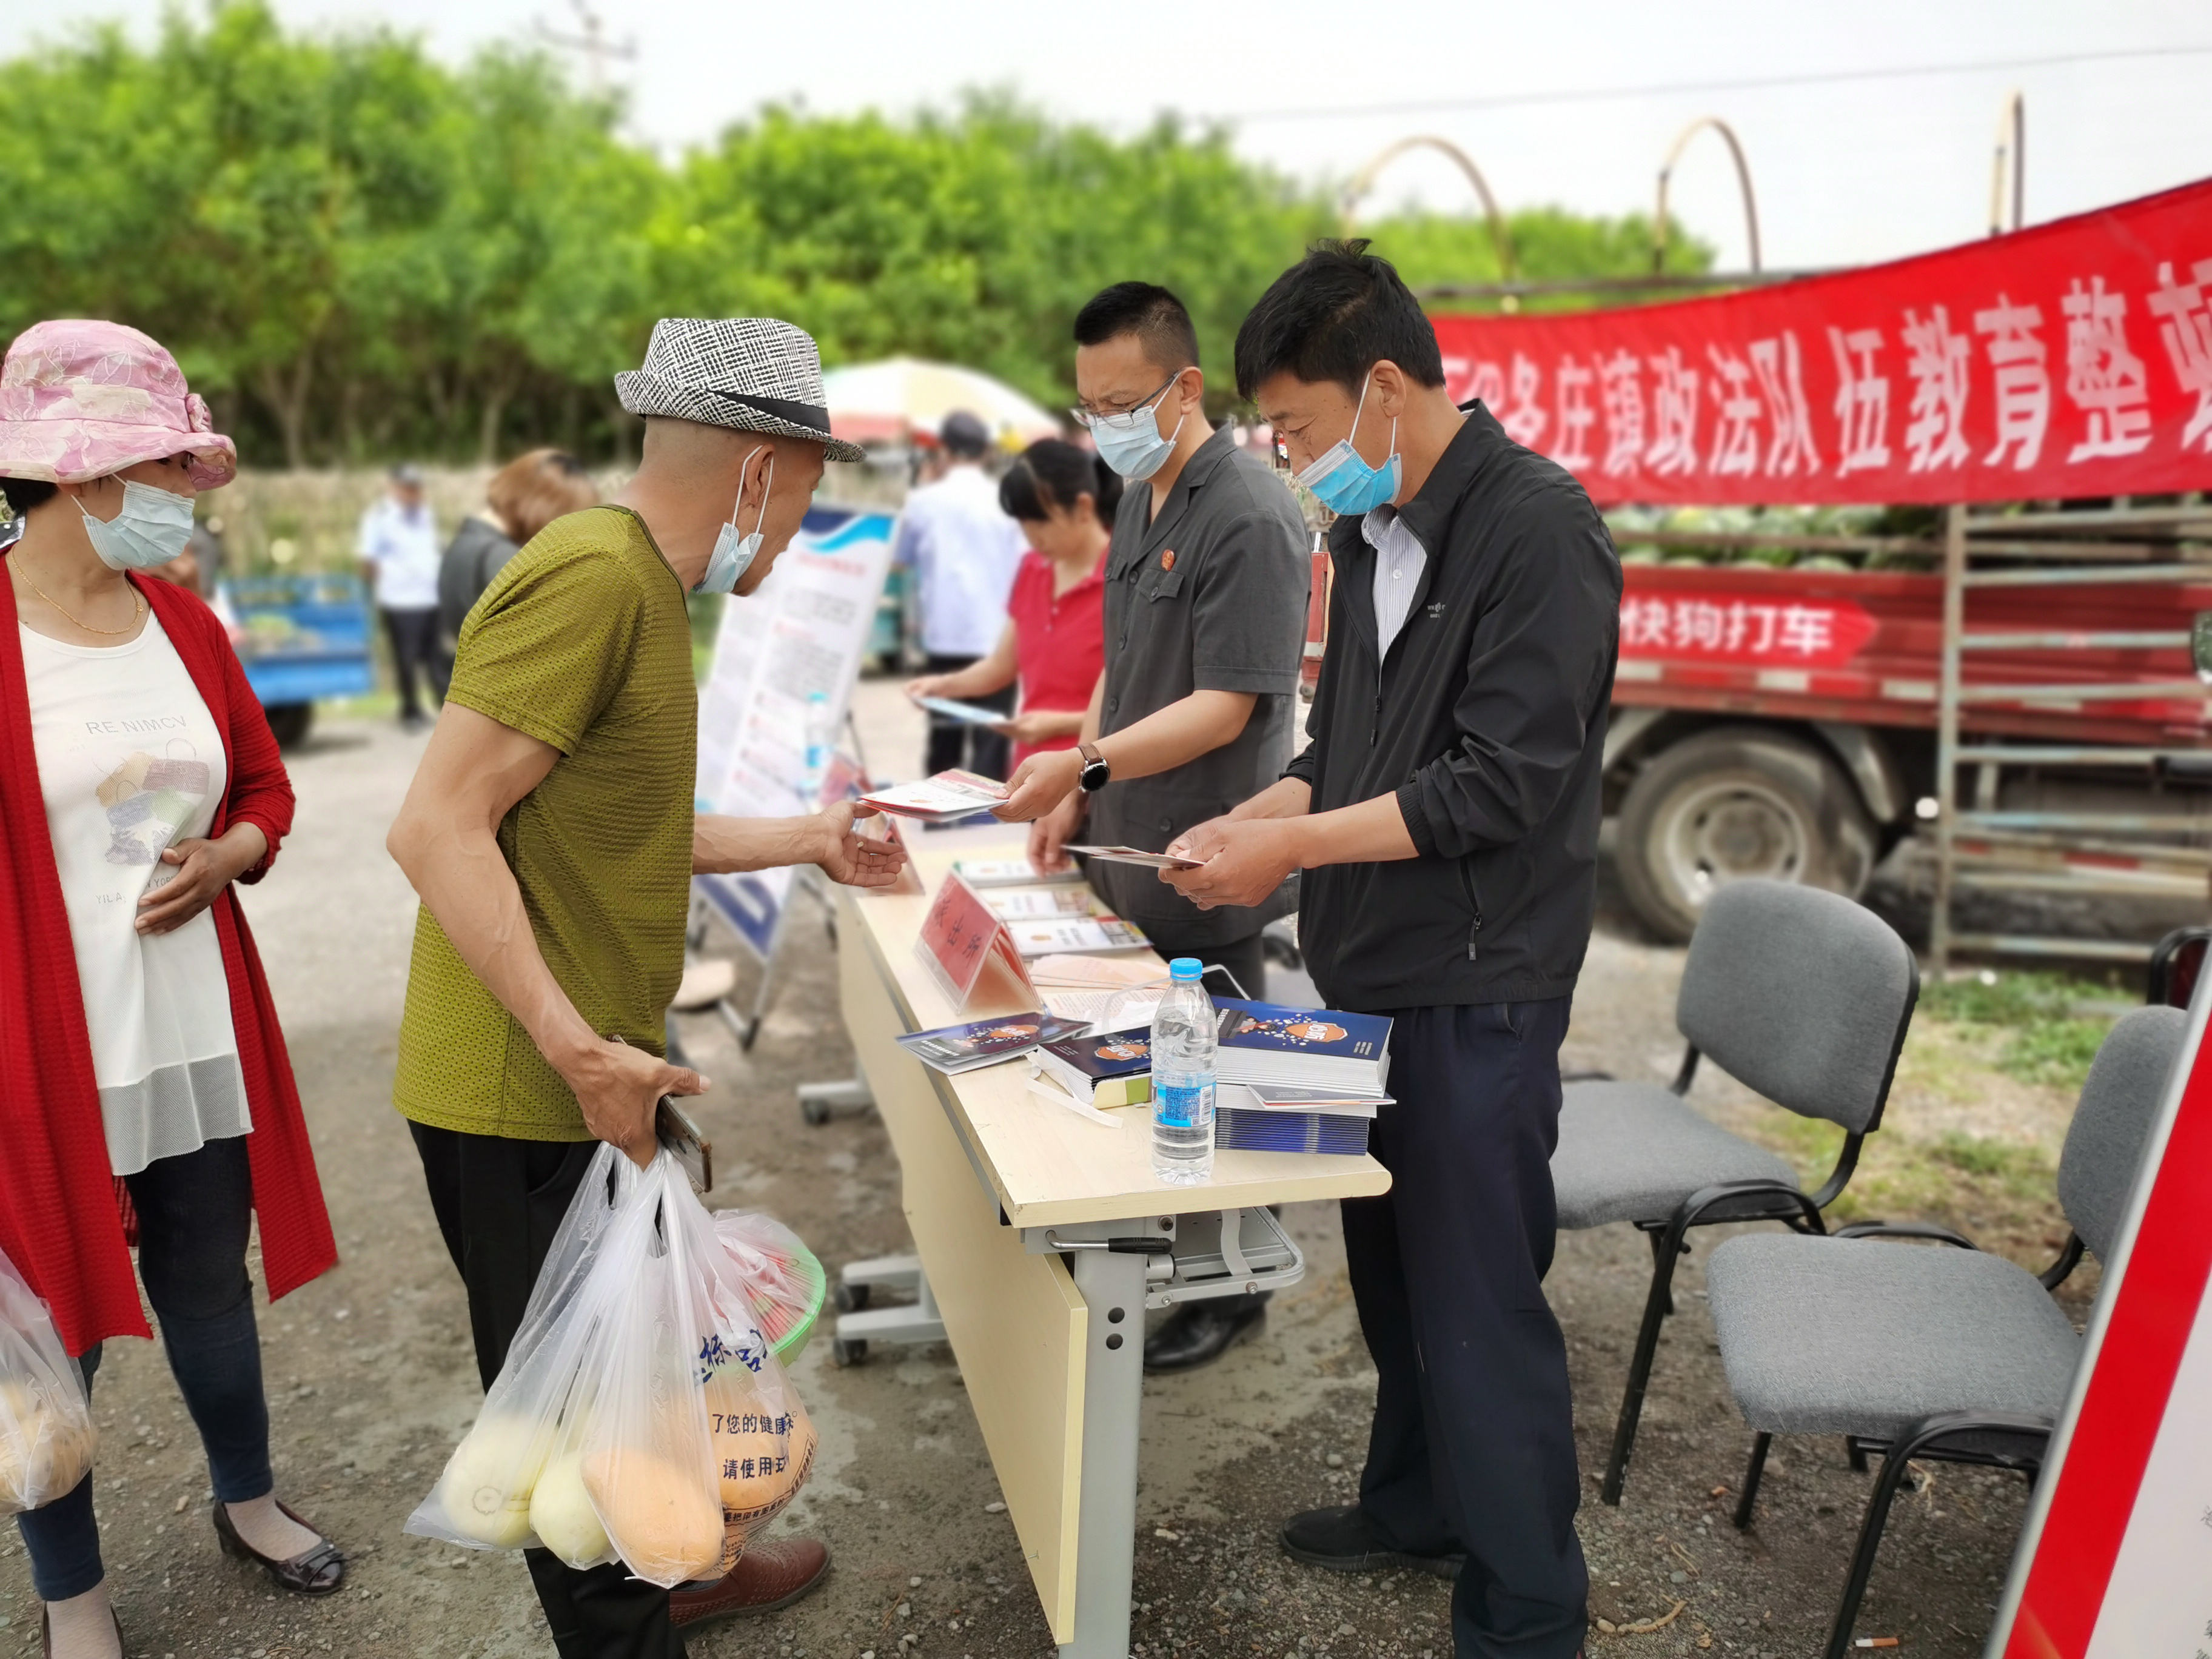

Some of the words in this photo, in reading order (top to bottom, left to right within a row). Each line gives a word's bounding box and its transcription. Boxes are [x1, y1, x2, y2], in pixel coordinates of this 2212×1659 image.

[1443, 259, 2212, 478] 各庄镇政法队伍教育整顿
[1620, 597, 1834, 656] 快狗打车
[85, 721, 119, 735] RE
[154, 875, 176, 888] YOR
[934, 897, 983, 968] 派出所
